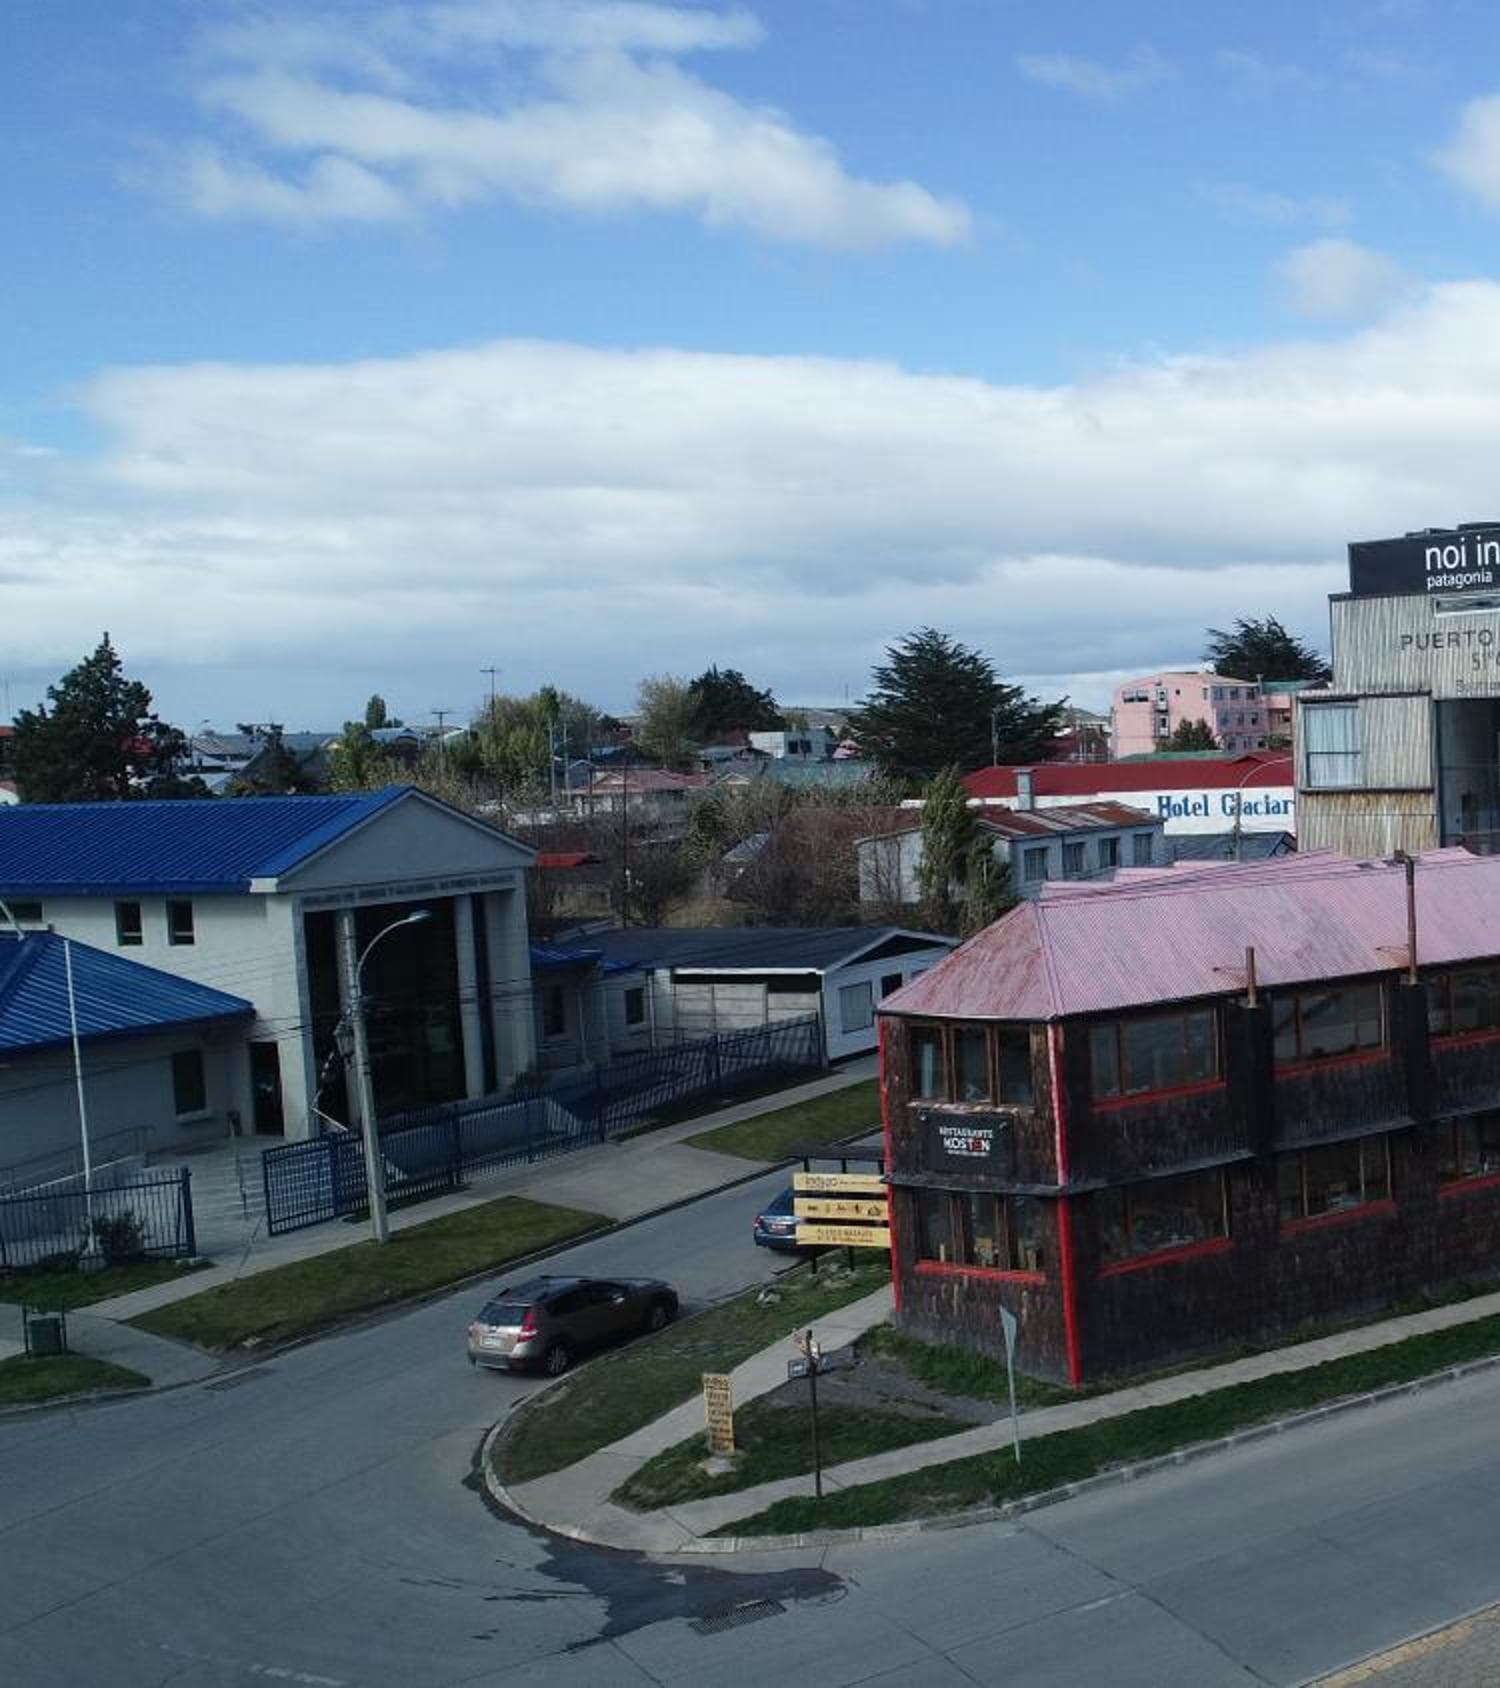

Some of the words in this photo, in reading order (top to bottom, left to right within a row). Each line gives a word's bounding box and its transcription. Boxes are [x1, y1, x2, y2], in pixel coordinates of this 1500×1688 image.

[1425, 537, 1466, 571] noi
[1426, 569, 1493, 591] patagonia
[1401, 628, 1493, 651] PUERTO
[1157, 793, 1209, 819] Hotel
